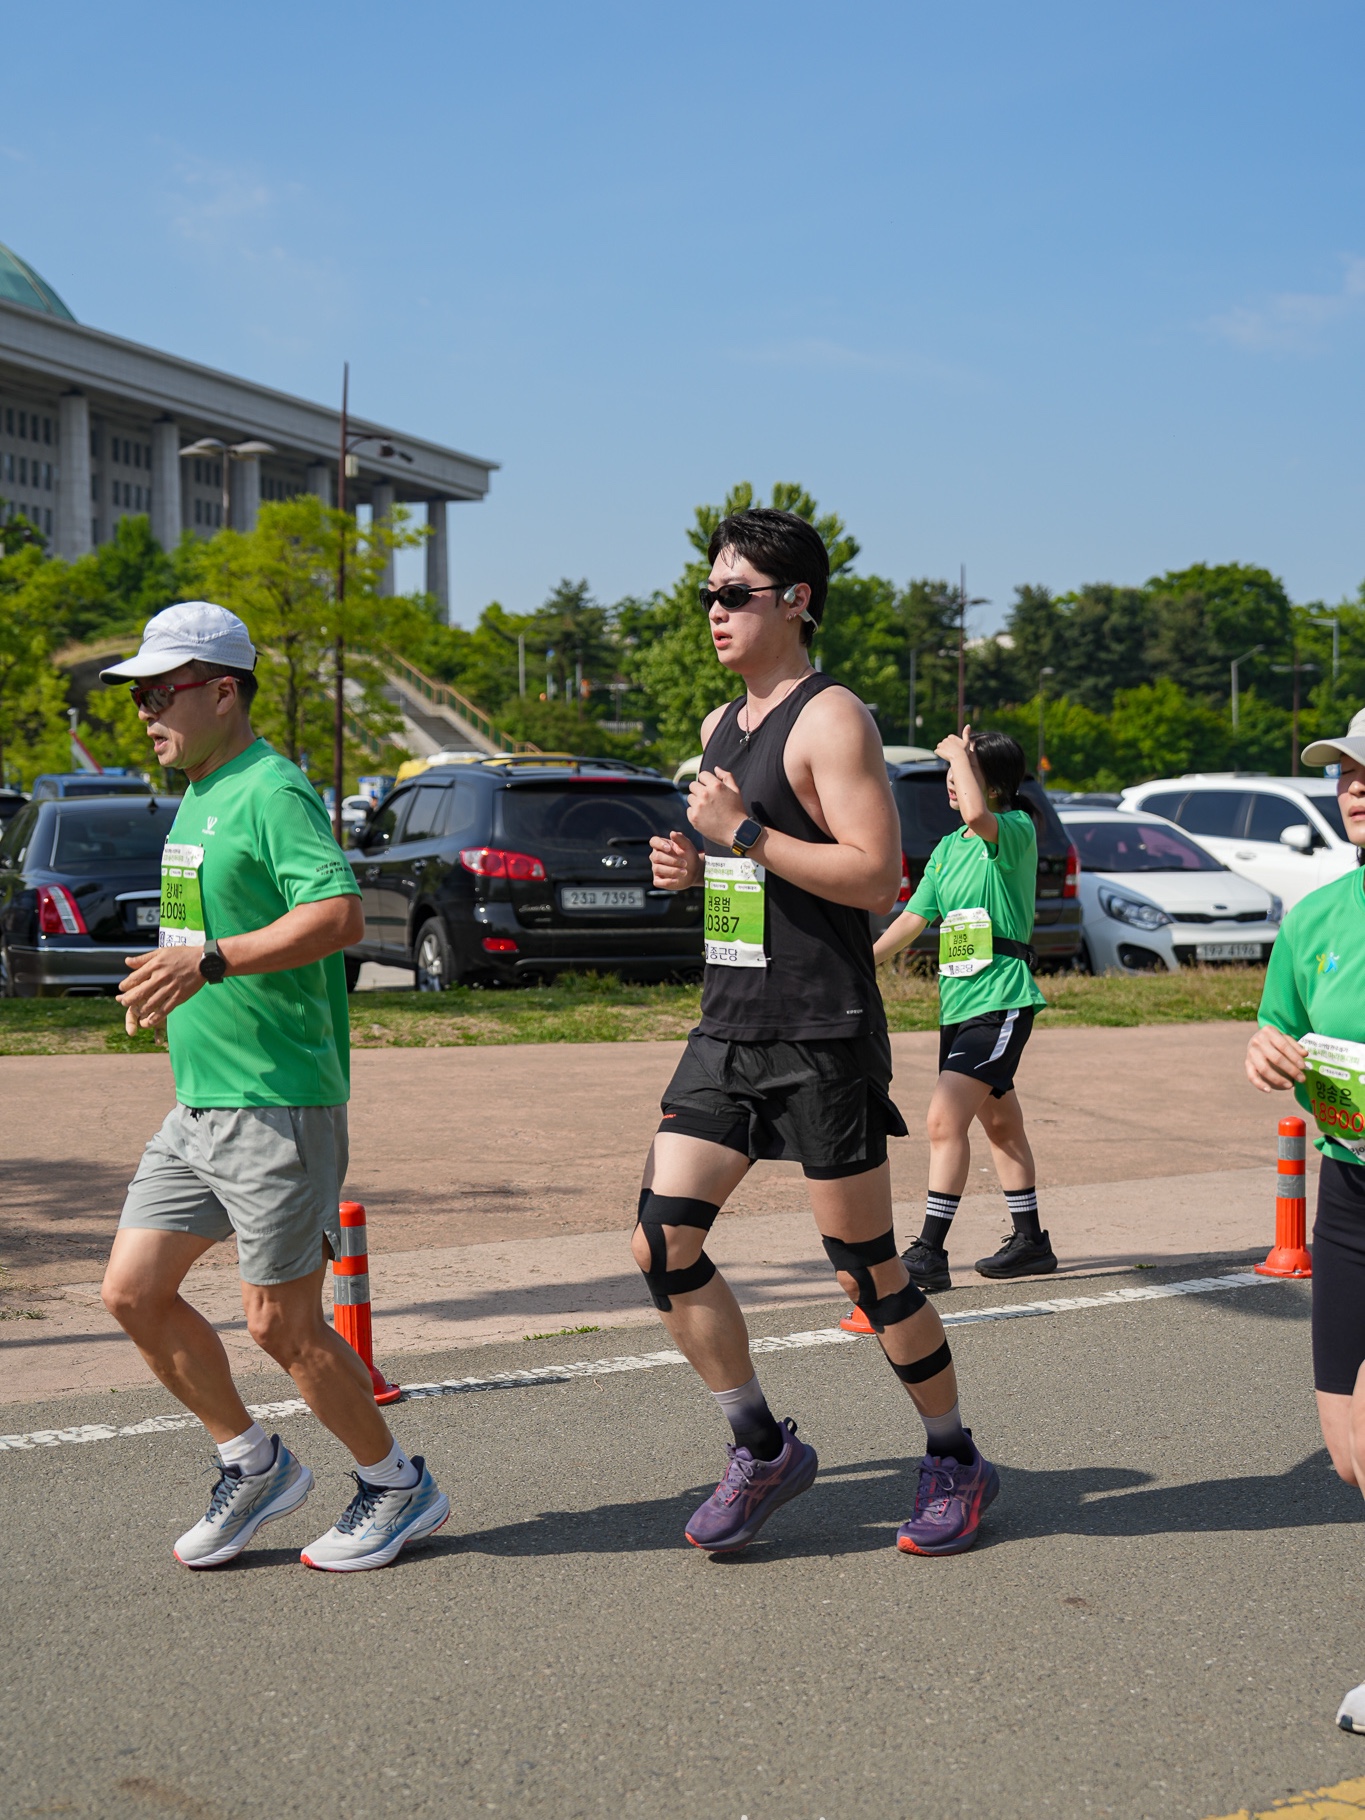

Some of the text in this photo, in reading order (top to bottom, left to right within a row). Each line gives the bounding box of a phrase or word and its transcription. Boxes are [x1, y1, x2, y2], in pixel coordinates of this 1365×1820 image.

[602, 891, 636, 905] 7395
[706, 914, 740, 934] 0387
[710, 947, 738, 962] 종근당
[948, 944, 975, 958] 10556
[1311, 1099, 1365, 1133] 18900
